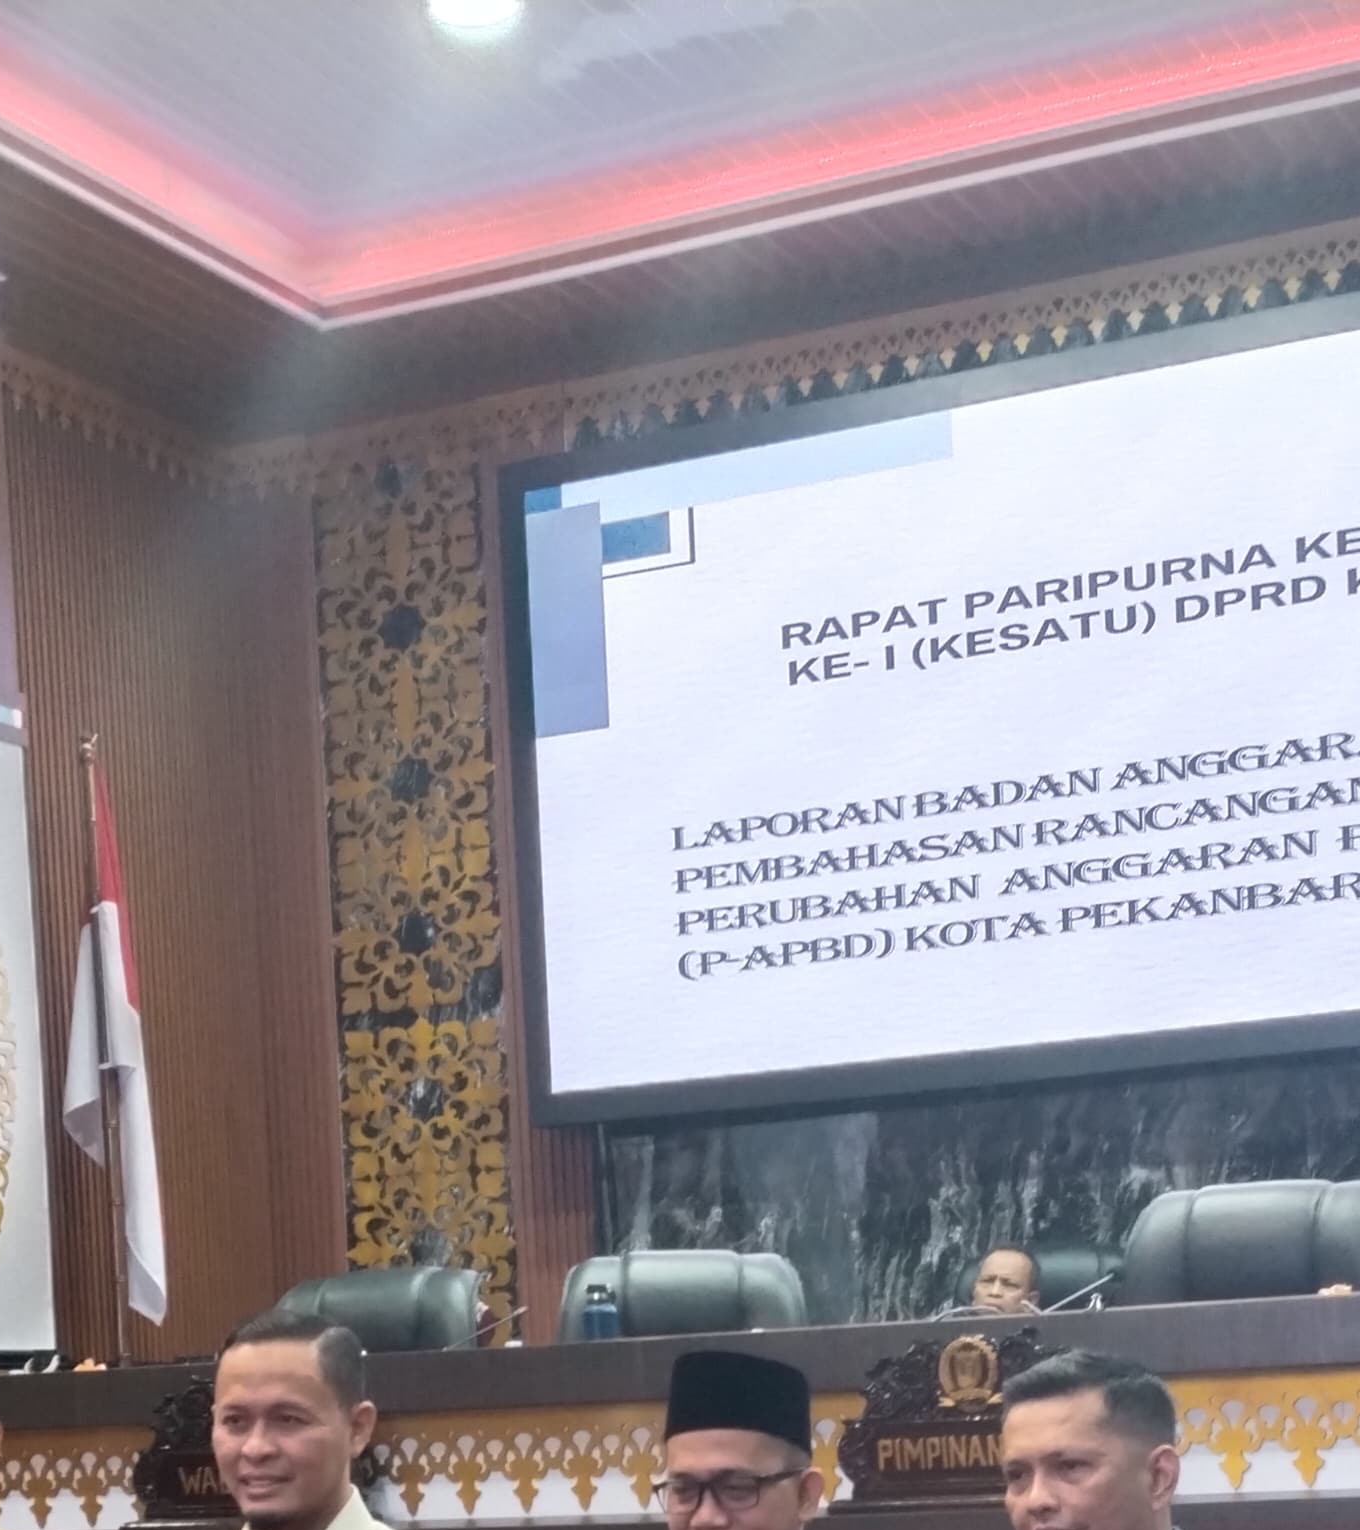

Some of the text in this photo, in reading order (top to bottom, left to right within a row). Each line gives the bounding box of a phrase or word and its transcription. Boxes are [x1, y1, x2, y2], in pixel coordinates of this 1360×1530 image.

[782, 598, 947, 649] RAPAT
[965, 544, 1277, 619] PARIPURNA
[912, 601, 1156, 670] (KESATU)
[1175, 576, 1326, 623] DPRD
[672, 795, 906, 851] LAPORAN
[912, 767, 1102, 818] BADAN
[676, 824, 1024, 894] PEMBAHASAN
[678, 874, 980, 936] PERUBAHAN
[999, 830, 1318, 896] ANGGARAN
[678, 928, 895, 981] (P-APBD)
[904, 912, 1048, 952] KOTA
[877, 1433, 1003, 1472] PIMPINAN
